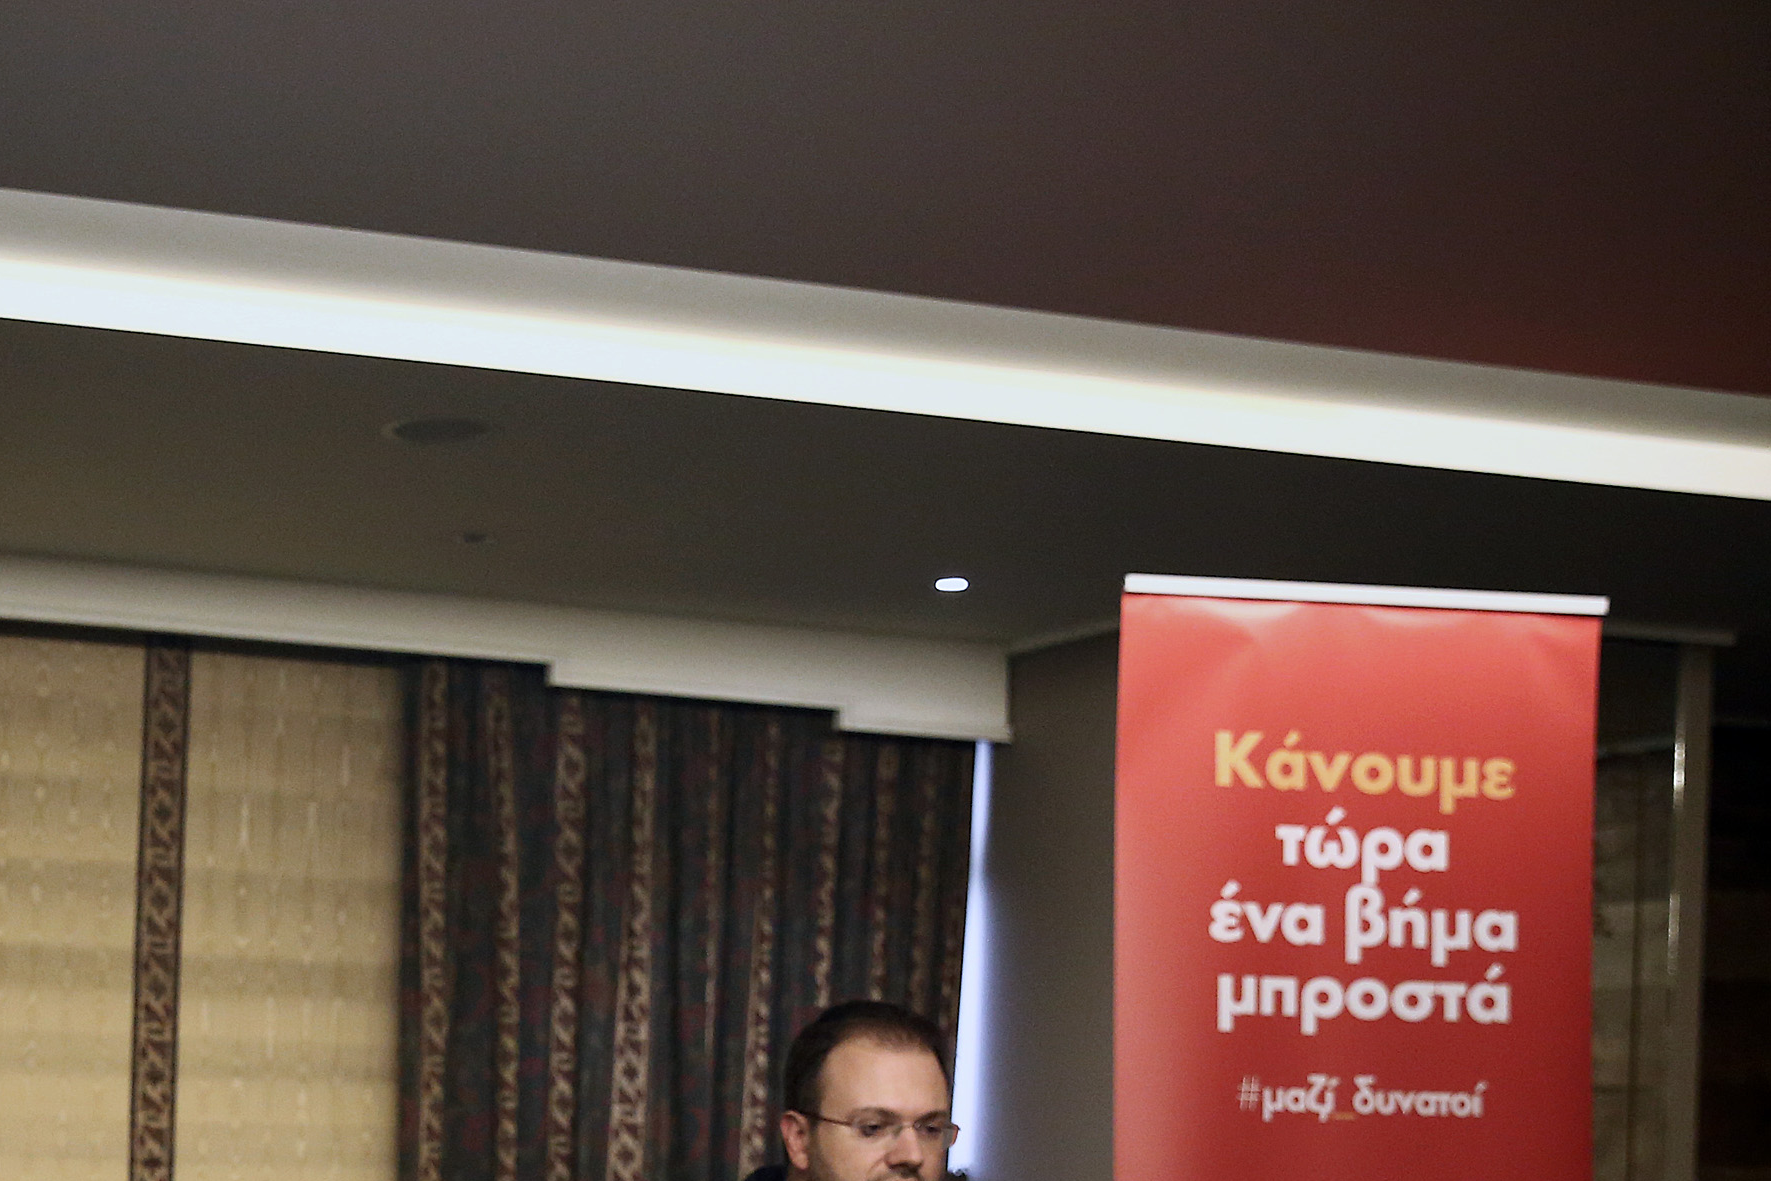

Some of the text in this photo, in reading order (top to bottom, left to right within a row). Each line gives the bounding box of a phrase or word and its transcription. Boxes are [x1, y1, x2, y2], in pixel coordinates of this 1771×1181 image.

[1214, 729, 1515, 815] Κάνουμε
[1275, 806, 1450, 884] τώρα
[1208, 880, 1519, 967] ένα βήμα
[1216, 963, 1512, 1036] μπροστά
